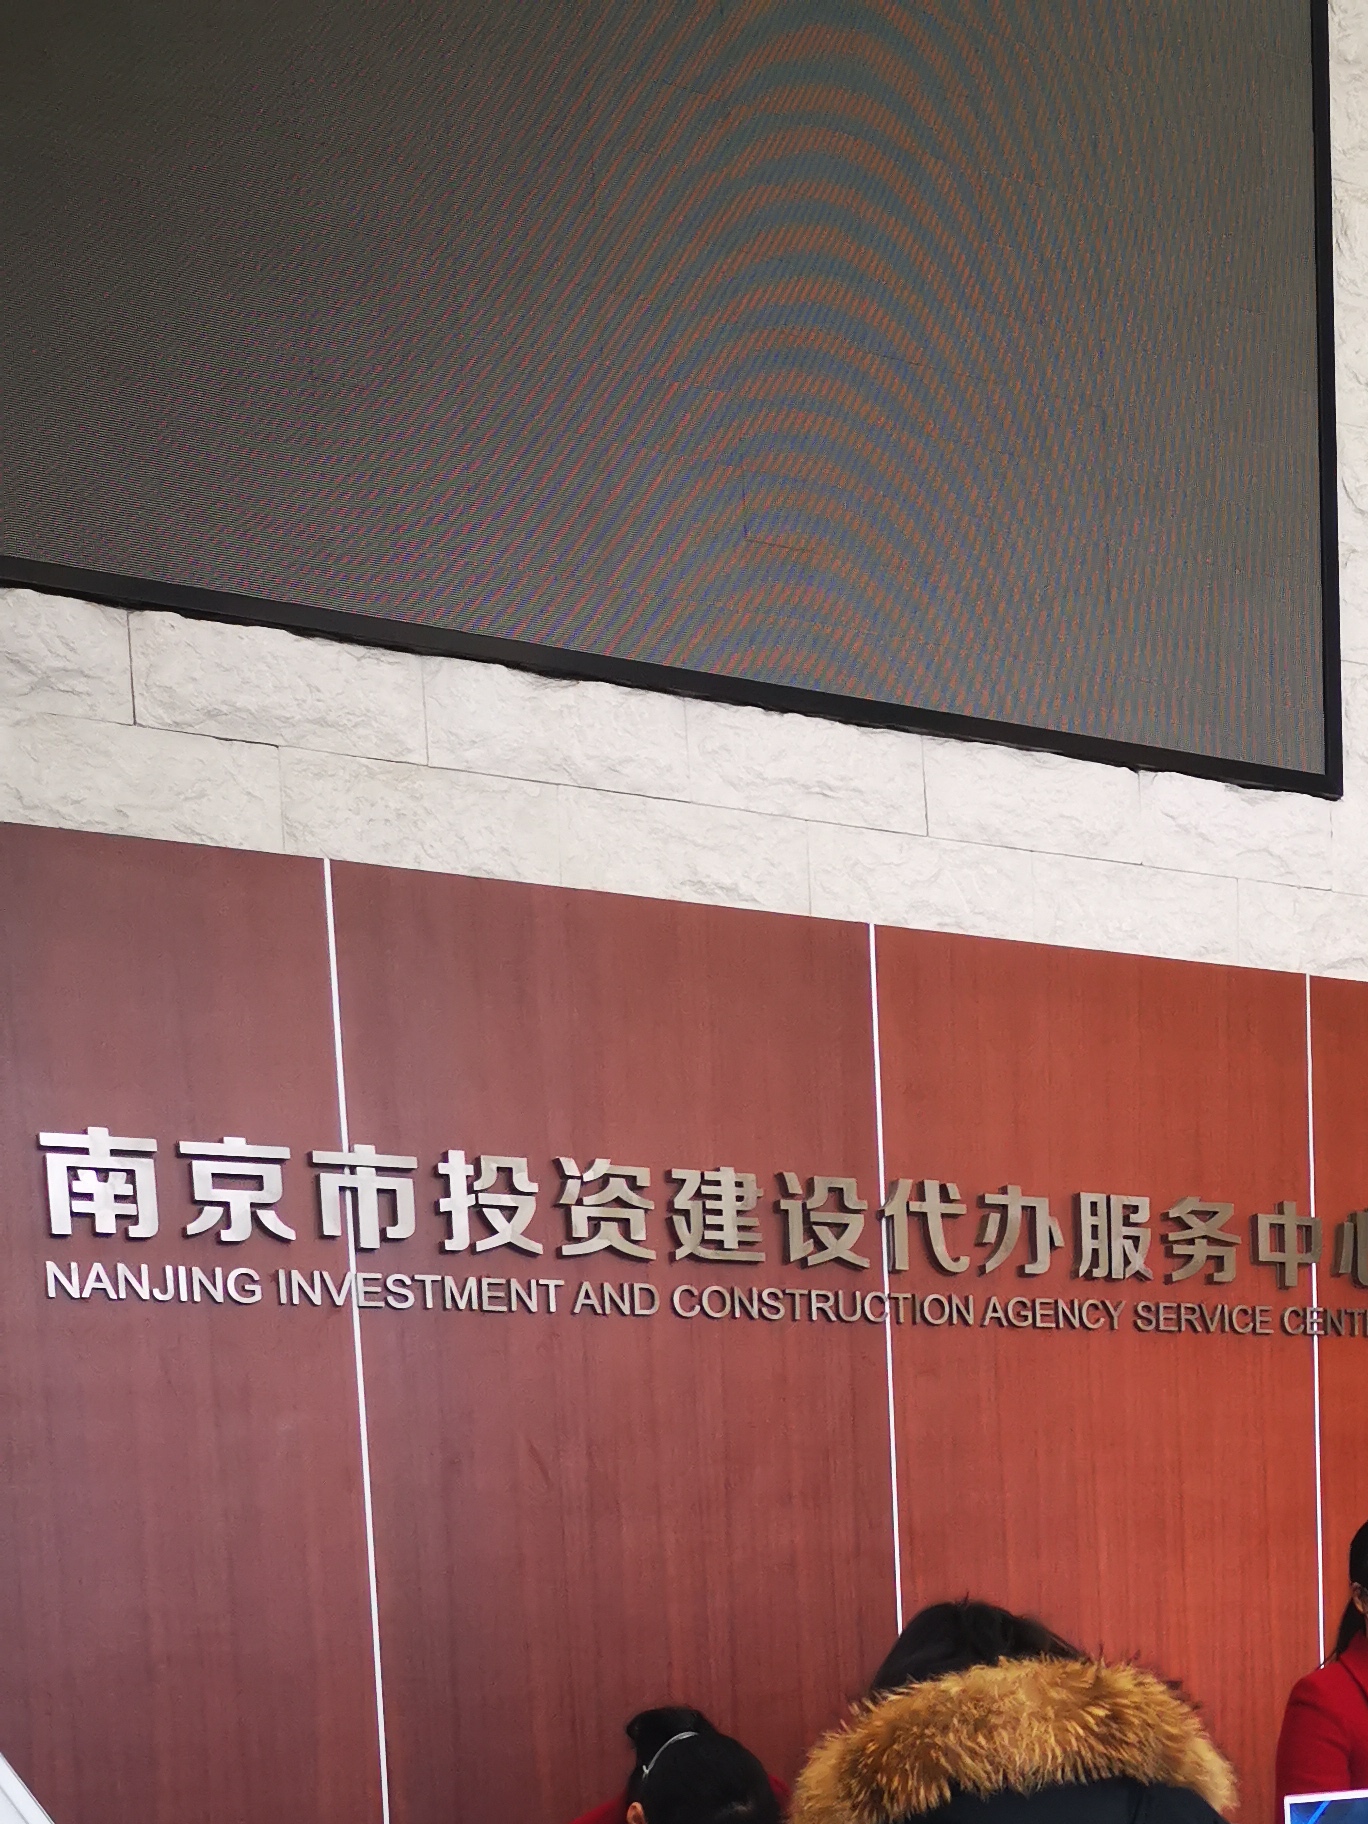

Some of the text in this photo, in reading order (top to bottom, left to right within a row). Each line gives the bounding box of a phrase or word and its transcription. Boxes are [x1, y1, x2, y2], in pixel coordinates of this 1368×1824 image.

[44, 1261, 263, 1305] NANJING
[277, 1268, 565, 1314] INVESTMENT
[573, 1280, 660, 1317] AND
[672, 1283, 975, 1328] CONSTRUCTION
[981, 1295, 1127, 1332] AGENCY
[1133, 1301, 1275, 1335] SERVICE
